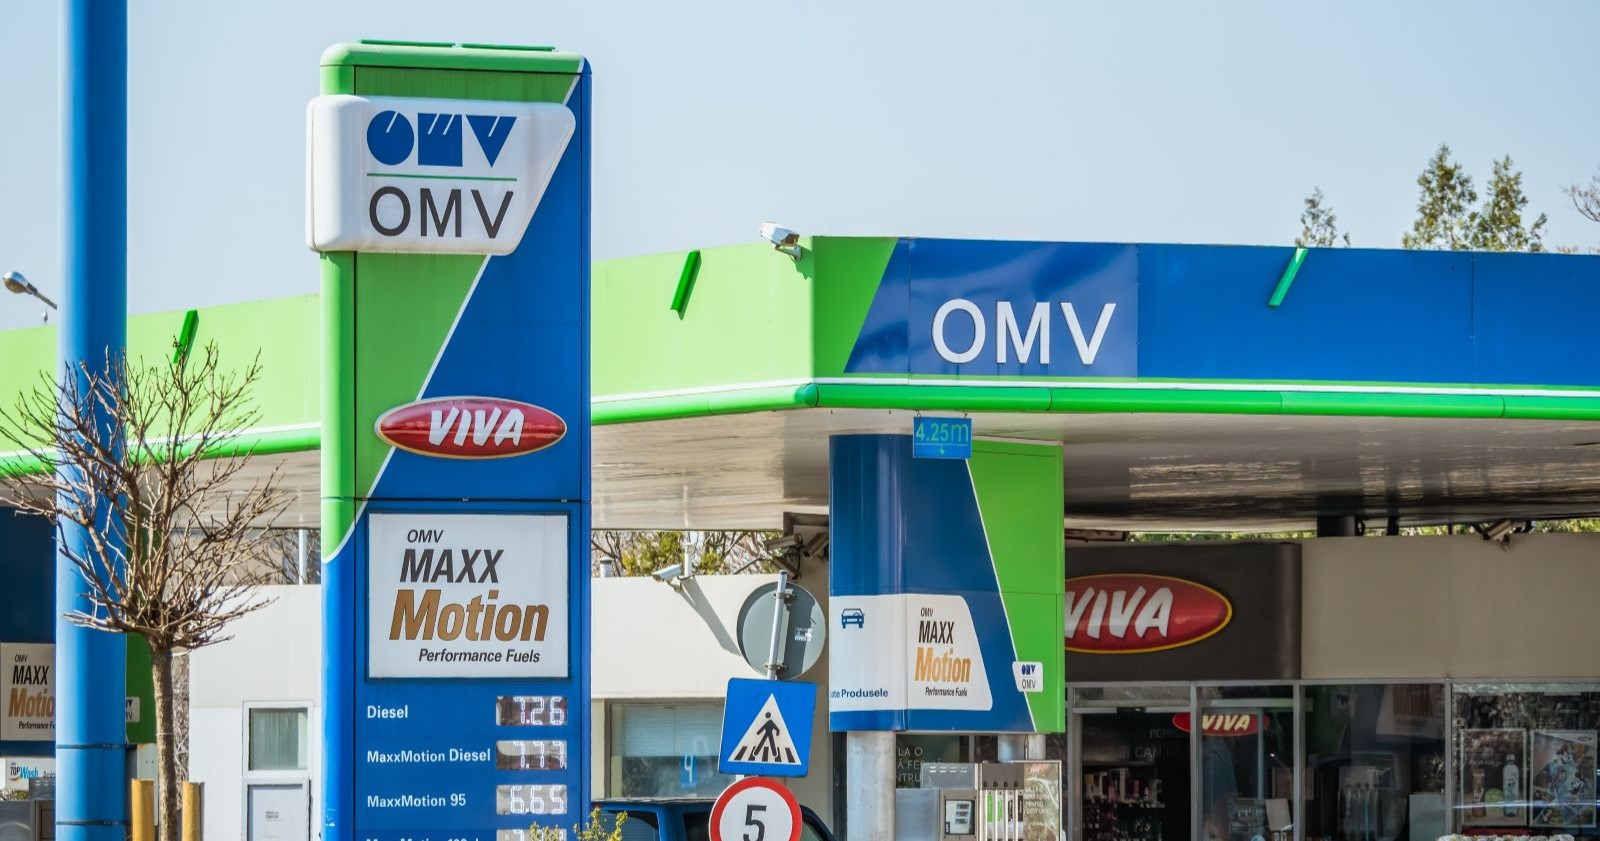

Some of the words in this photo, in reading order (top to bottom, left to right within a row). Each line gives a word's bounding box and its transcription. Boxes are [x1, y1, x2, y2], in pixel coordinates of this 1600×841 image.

[369, 186, 514, 239] OMV
[932, 298, 1117, 366] OMV
[428, 406, 525, 447] VIVA
[407, 529, 444, 543] OMV
[400, 549, 504, 584] MAXX
[389, 589, 549, 642] Motion
[920, 607, 934, 617] OMV
[1065, 585, 1174, 640] VIVA
[918, 621, 954, 644] MAXX
[14, 654, 28, 663] OMV
[418, 648, 502, 663] Performance
[506, 649, 541, 664] Fuels
[914, 646, 970, 683] Motion
[12, 665, 50, 686] MAXX
[1021, 679, 1036, 690] OMV
[841, 688, 889, 699] Produsele
[925, 686, 955, 697] Performance
[956, 687, 967, 698] Fuels
[366, 704, 409, 719] Diesel
[513, 696, 565, 726] 7.26
[1201, 714, 1251, 731] VIVA
[366, 750, 446, 763] MaxxMotion
[449, 748, 491, 763] Diesel
[513, 740, 565, 769] 7.77
[366, 794, 446, 809] MaxxMotion
[450, 793, 467, 807] 95
[510, 785, 565, 814] 6.65
[743, 804, 767, 841] 5
